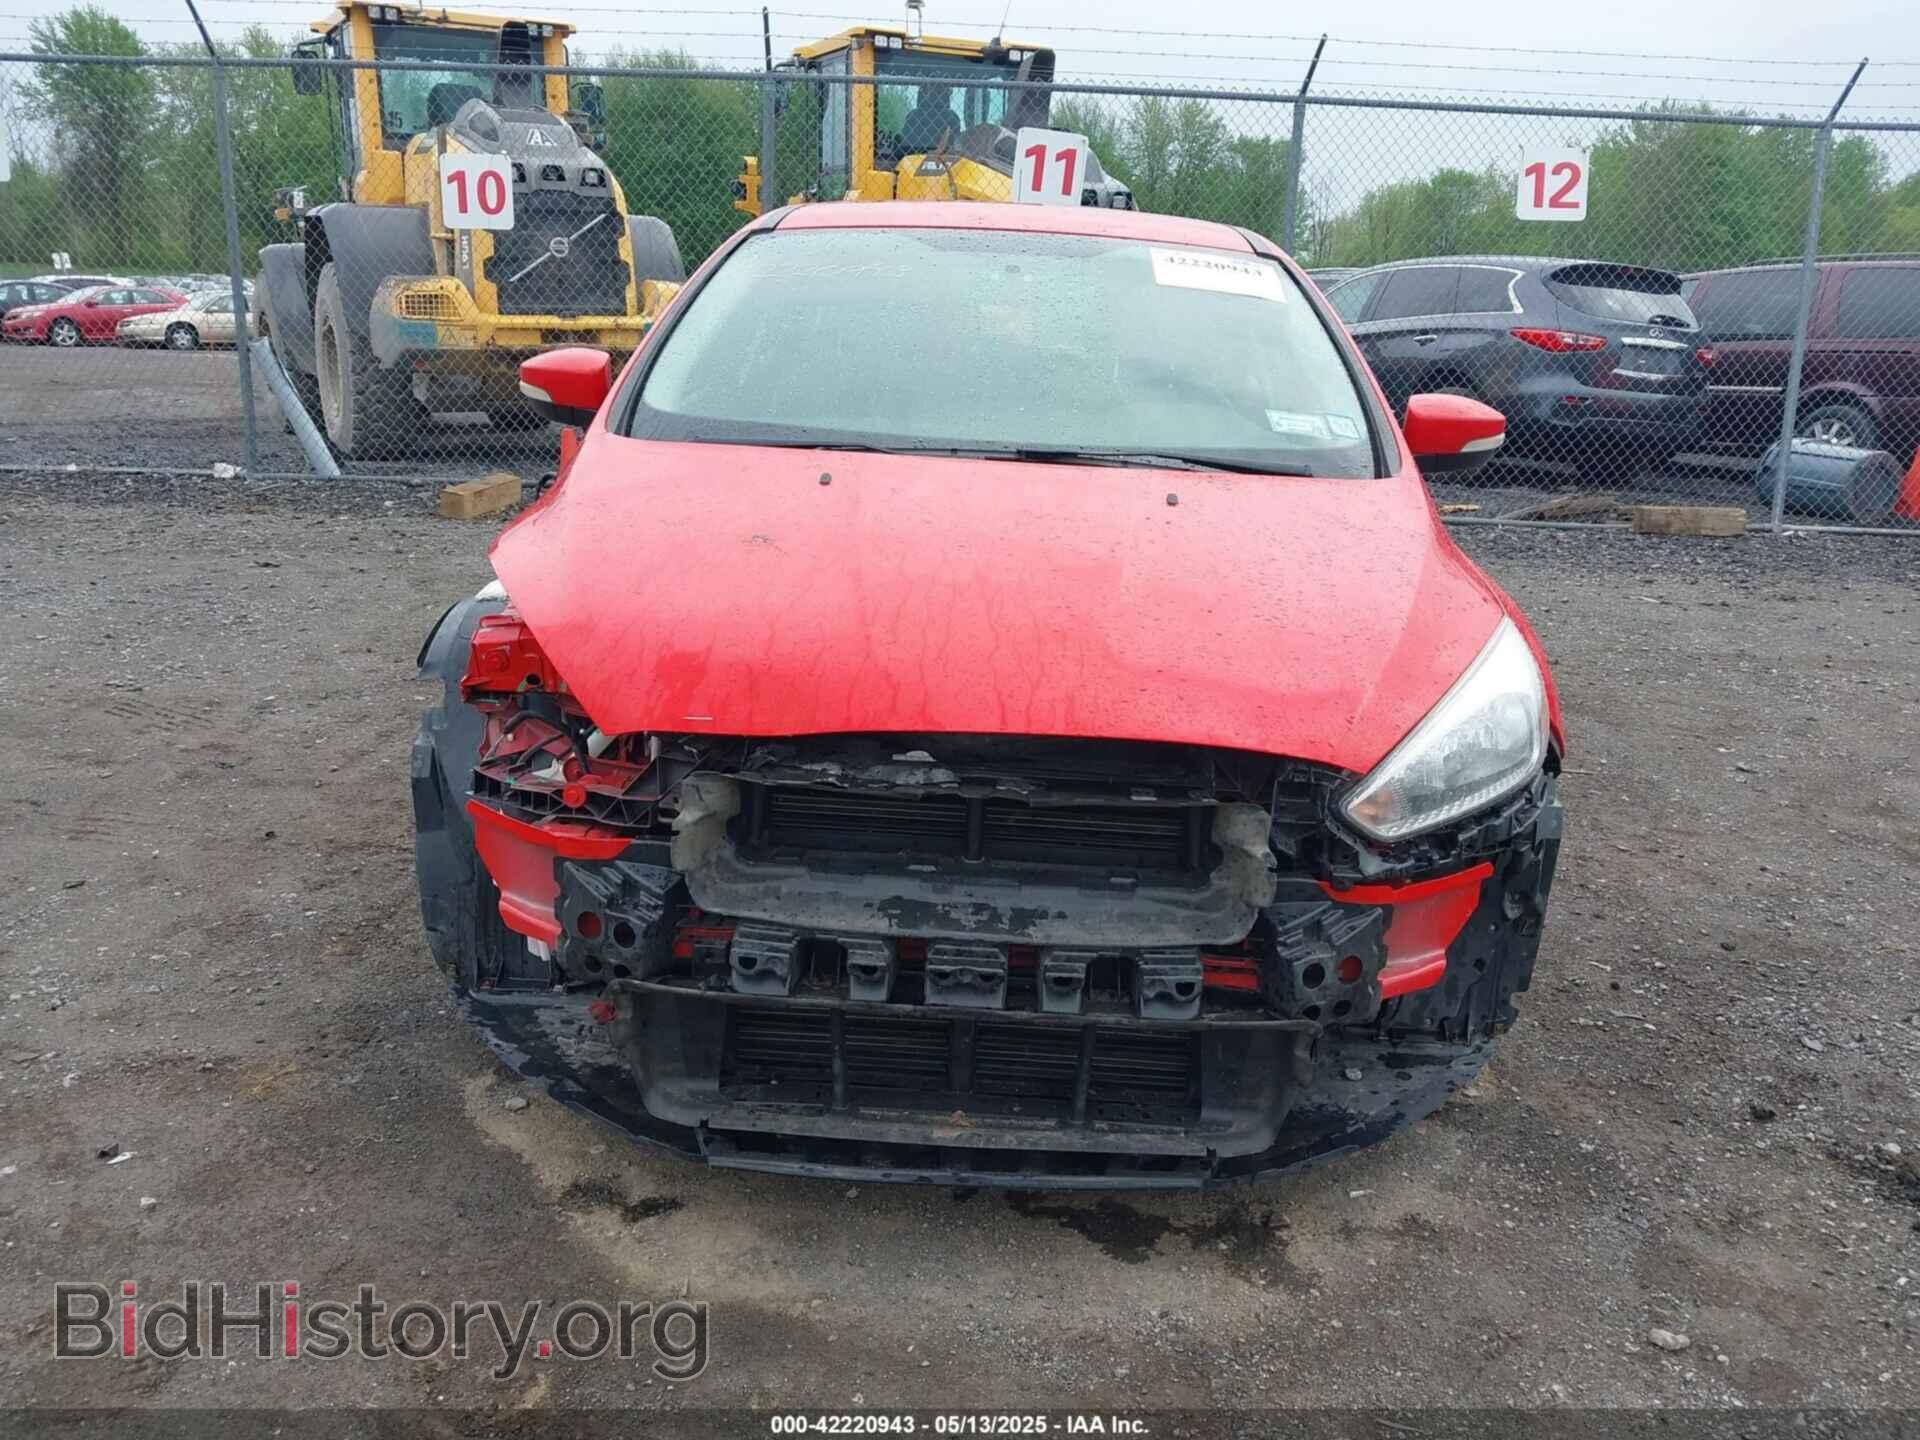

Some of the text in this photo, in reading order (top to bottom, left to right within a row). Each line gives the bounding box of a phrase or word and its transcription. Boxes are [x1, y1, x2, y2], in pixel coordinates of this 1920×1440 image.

[447, 170, 506, 215] 10
[1025, 144, 1077, 196] 11
[1525, 162, 1581, 208] 12
